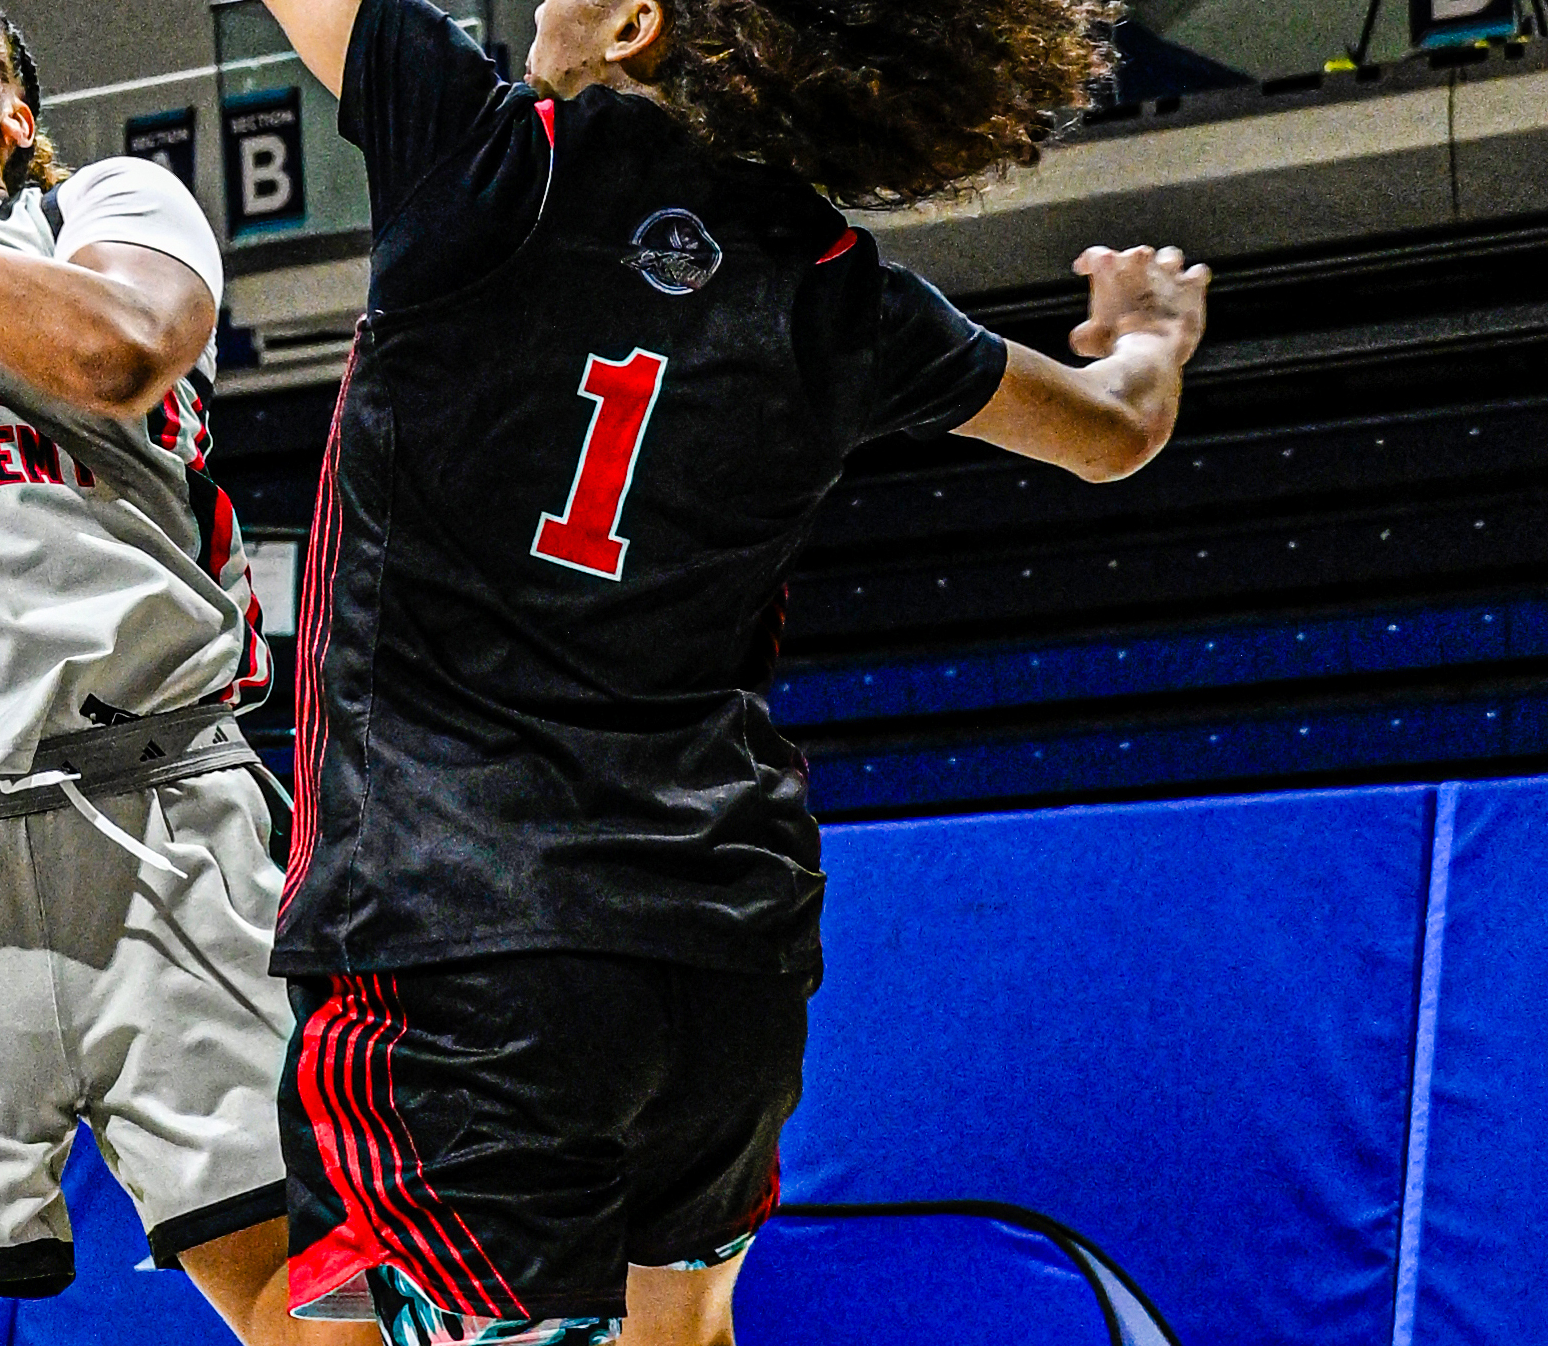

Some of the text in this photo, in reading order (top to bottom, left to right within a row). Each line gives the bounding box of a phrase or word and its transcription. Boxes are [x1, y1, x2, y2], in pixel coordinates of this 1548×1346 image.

[231, 110, 296, 134] SECTION
[239, 134, 292, 216] B
[530, 347, 668, 582] 1
